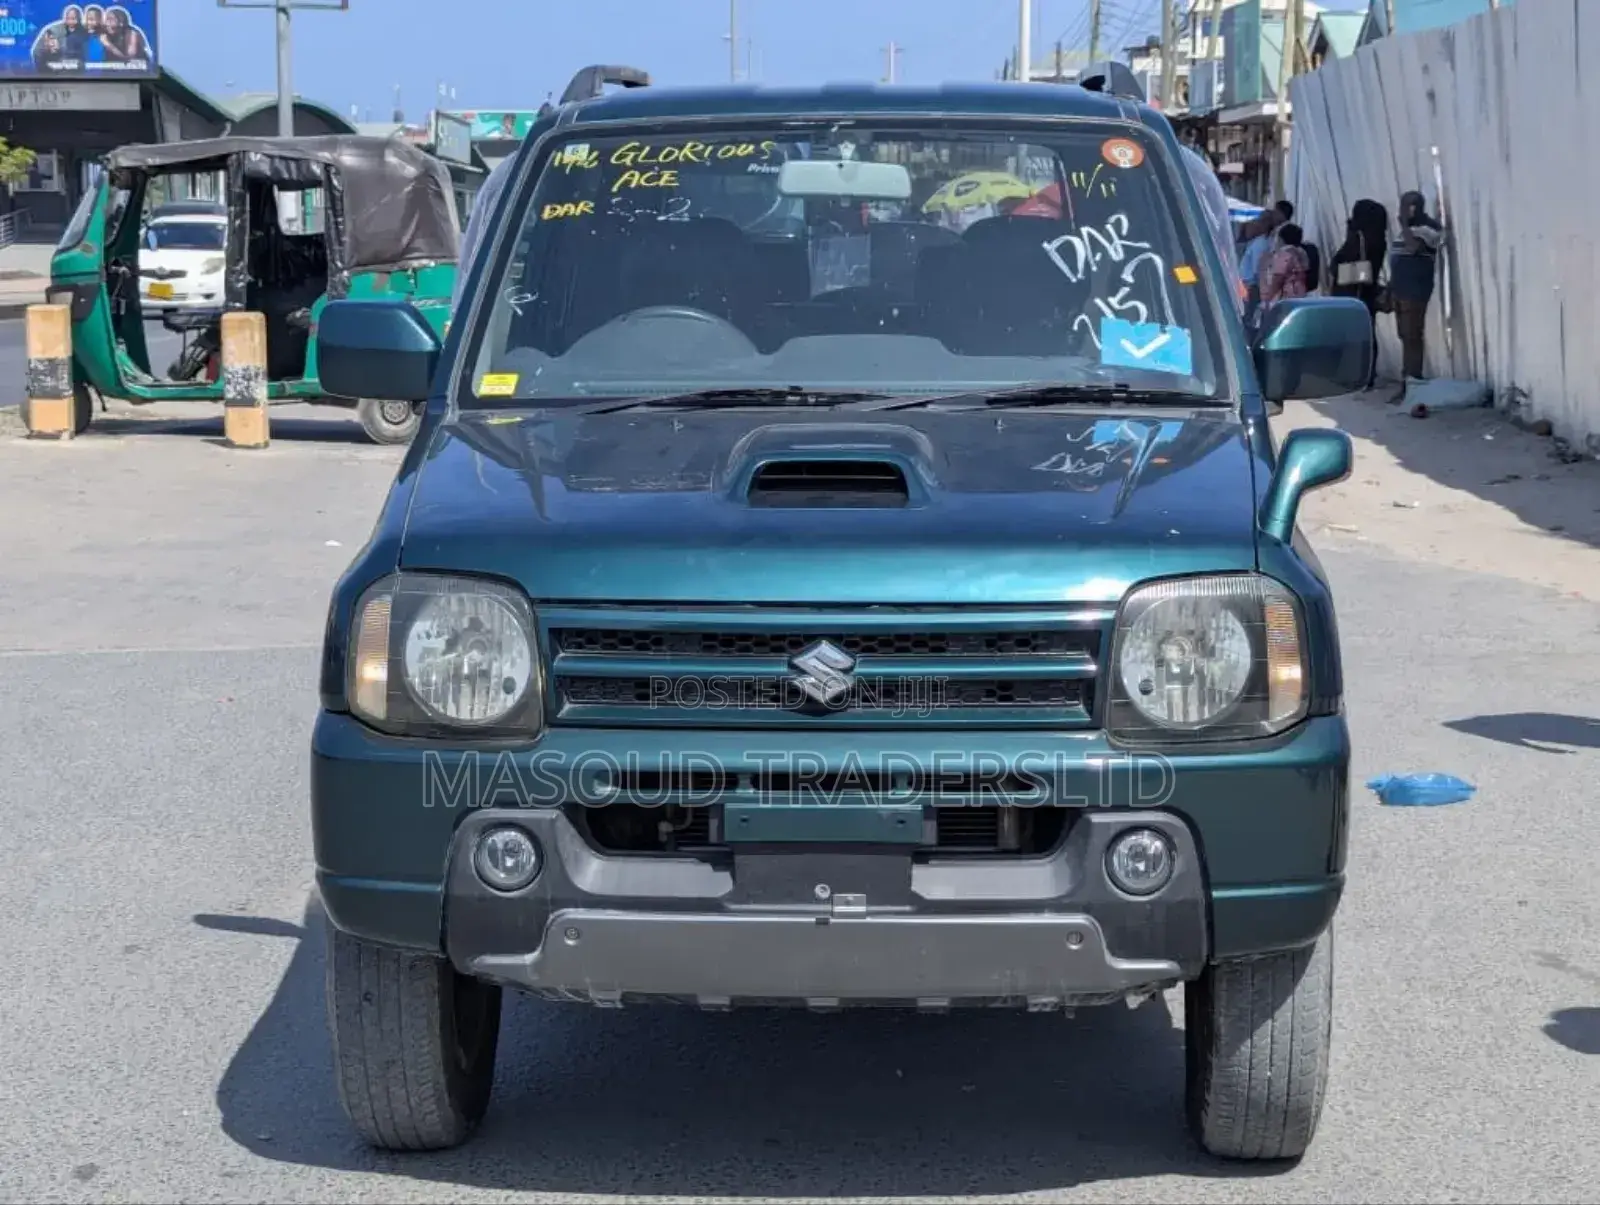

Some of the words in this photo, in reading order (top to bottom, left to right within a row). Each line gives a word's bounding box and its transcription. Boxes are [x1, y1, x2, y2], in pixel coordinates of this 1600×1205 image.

[610, 141, 777, 167] GLORIOUS
[611, 170, 680, 193] ACE
[541, 200, 596, 221] DAR
